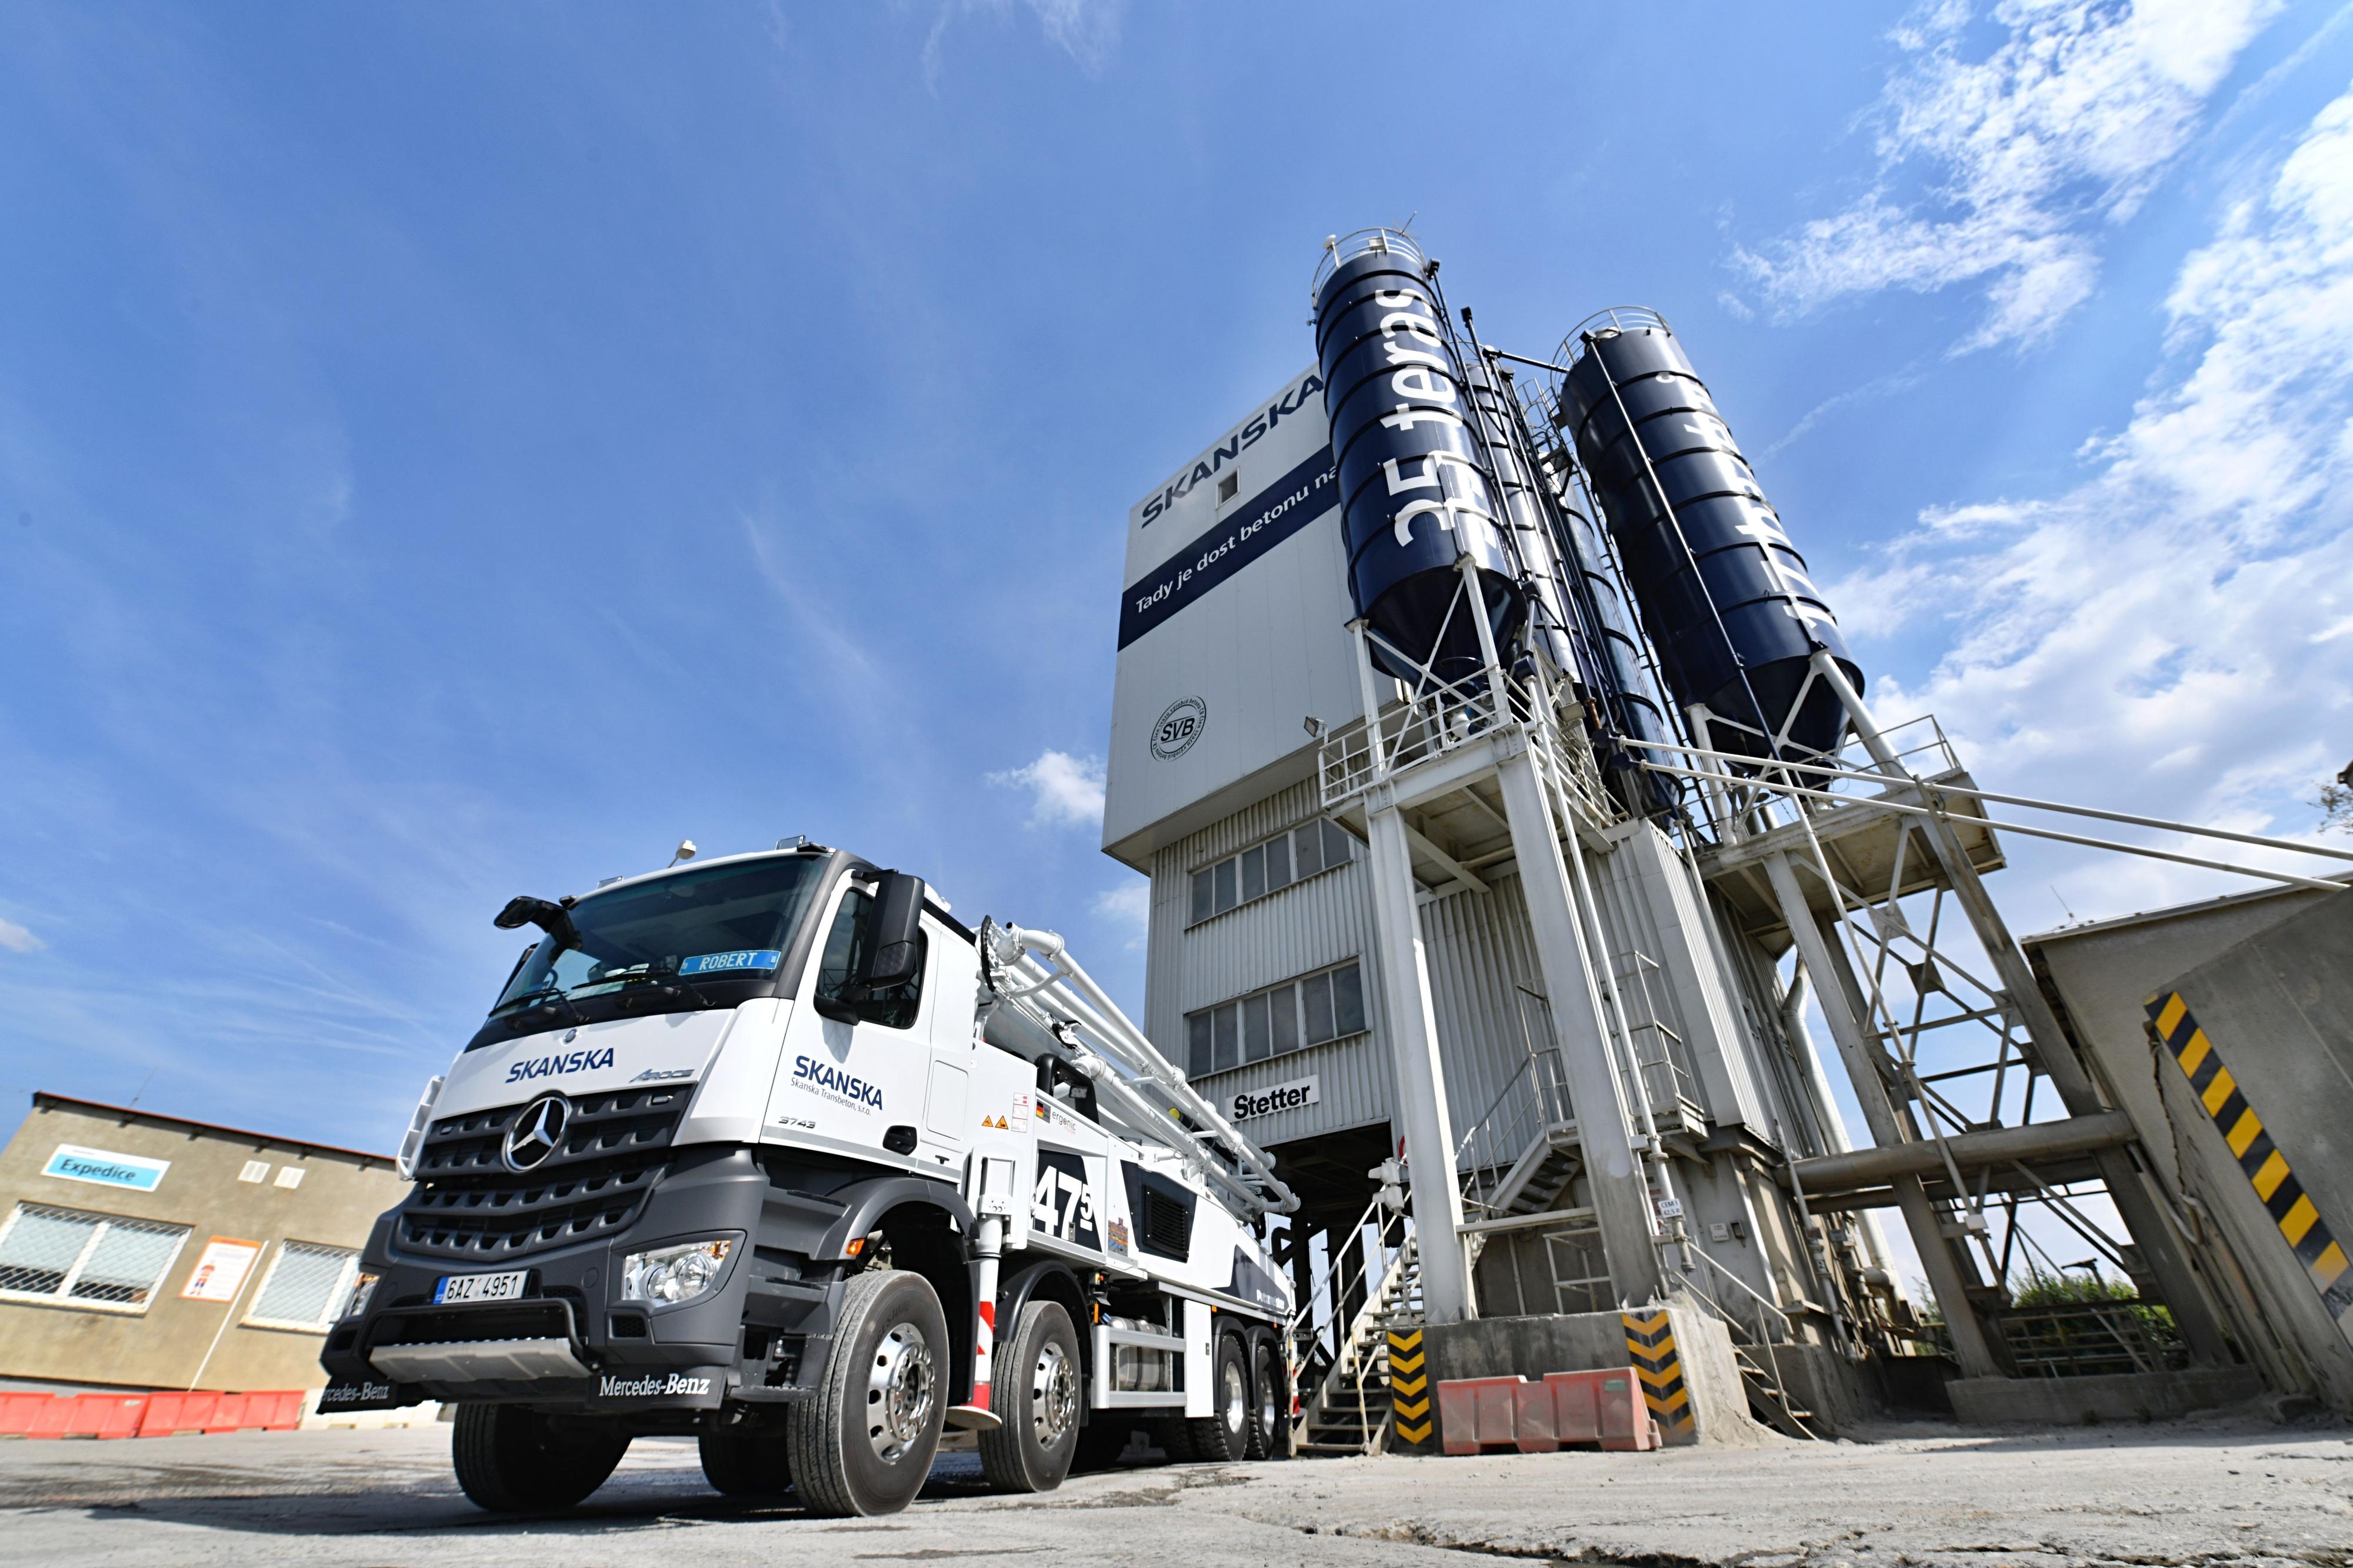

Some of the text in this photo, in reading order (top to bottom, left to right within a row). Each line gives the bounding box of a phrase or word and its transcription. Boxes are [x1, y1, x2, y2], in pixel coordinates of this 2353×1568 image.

[1375, 288, 1497, 548] 35 teras
[1141, 374, 1324, 529] SKANSKA
[1136, 581, 1174, 613] Tady
[1176, 568, 1192, 590] je
[1197, 536, 1236, 571] dost
[1240, 486, 1309, 541] betonu
[1161, 718, 1195, 742] SVB
[699, 952, 758, 970] ROBERT
[505, 1047, 614, 1083] SKANSKA
[791, 1077, 871, 1116] Skanska Transbeton, s.r.o.
[793, 1055, 883, 1111] SKANSKA
[1234, 1085, 1310, 1119] Stetter
[778, 1116, 816, 1129] 3743
[1052, 1111, 1076, 1130] ergonic
[60, 1158, 136, 1181] Expedice
[446, 1275, 518, 1299] 6AZ 4951
[599, 1373, 711, 1396] Mercedes-Benz
